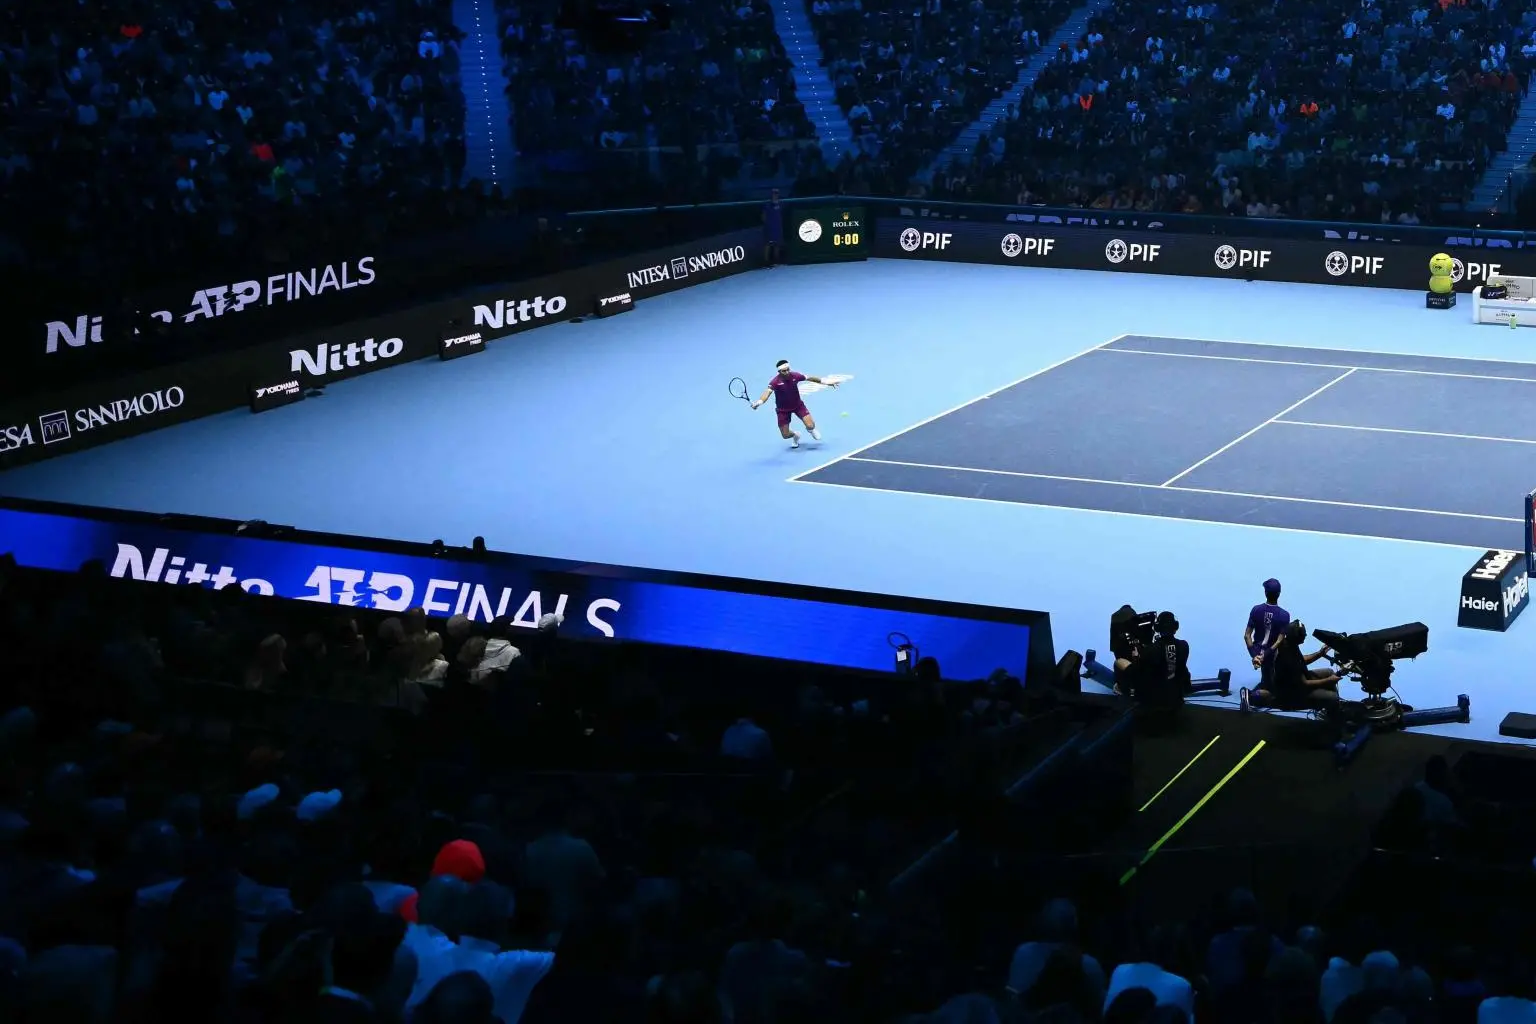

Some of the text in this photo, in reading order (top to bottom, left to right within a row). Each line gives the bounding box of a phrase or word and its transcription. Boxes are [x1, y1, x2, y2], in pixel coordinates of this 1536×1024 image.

[834, 234, 858, 245] 0:00
[926, 233, 952, 249] PIF
[1025, 238, 1054, 255] PIF
[1130, 244, 1160, 261] PIF
[1240, 250, 1271, 267] PIF
[627, 246, 744, 288] INTESA SANPAOLO
[1351, 256, 1384, 274] PIF
[1467, 263, 1502, 282] PIF
[184, 280, 260, 322] ATP
[268, 257, 375, 305] FINALS
[473, 295, 567, 329] Nitto
[452, 332, 482, 346] YOKOHAMA
[289, 338, 403, 375] Nitto
[265, 380, 300, 394] YOKOHAMA
[75, 387, 184, 431] SANPAOLO
[1469, 550, 1517, 580] Haier
[1461, 595, 1500, 611] Haier
[1501, 573, 1529, 618] Haier
